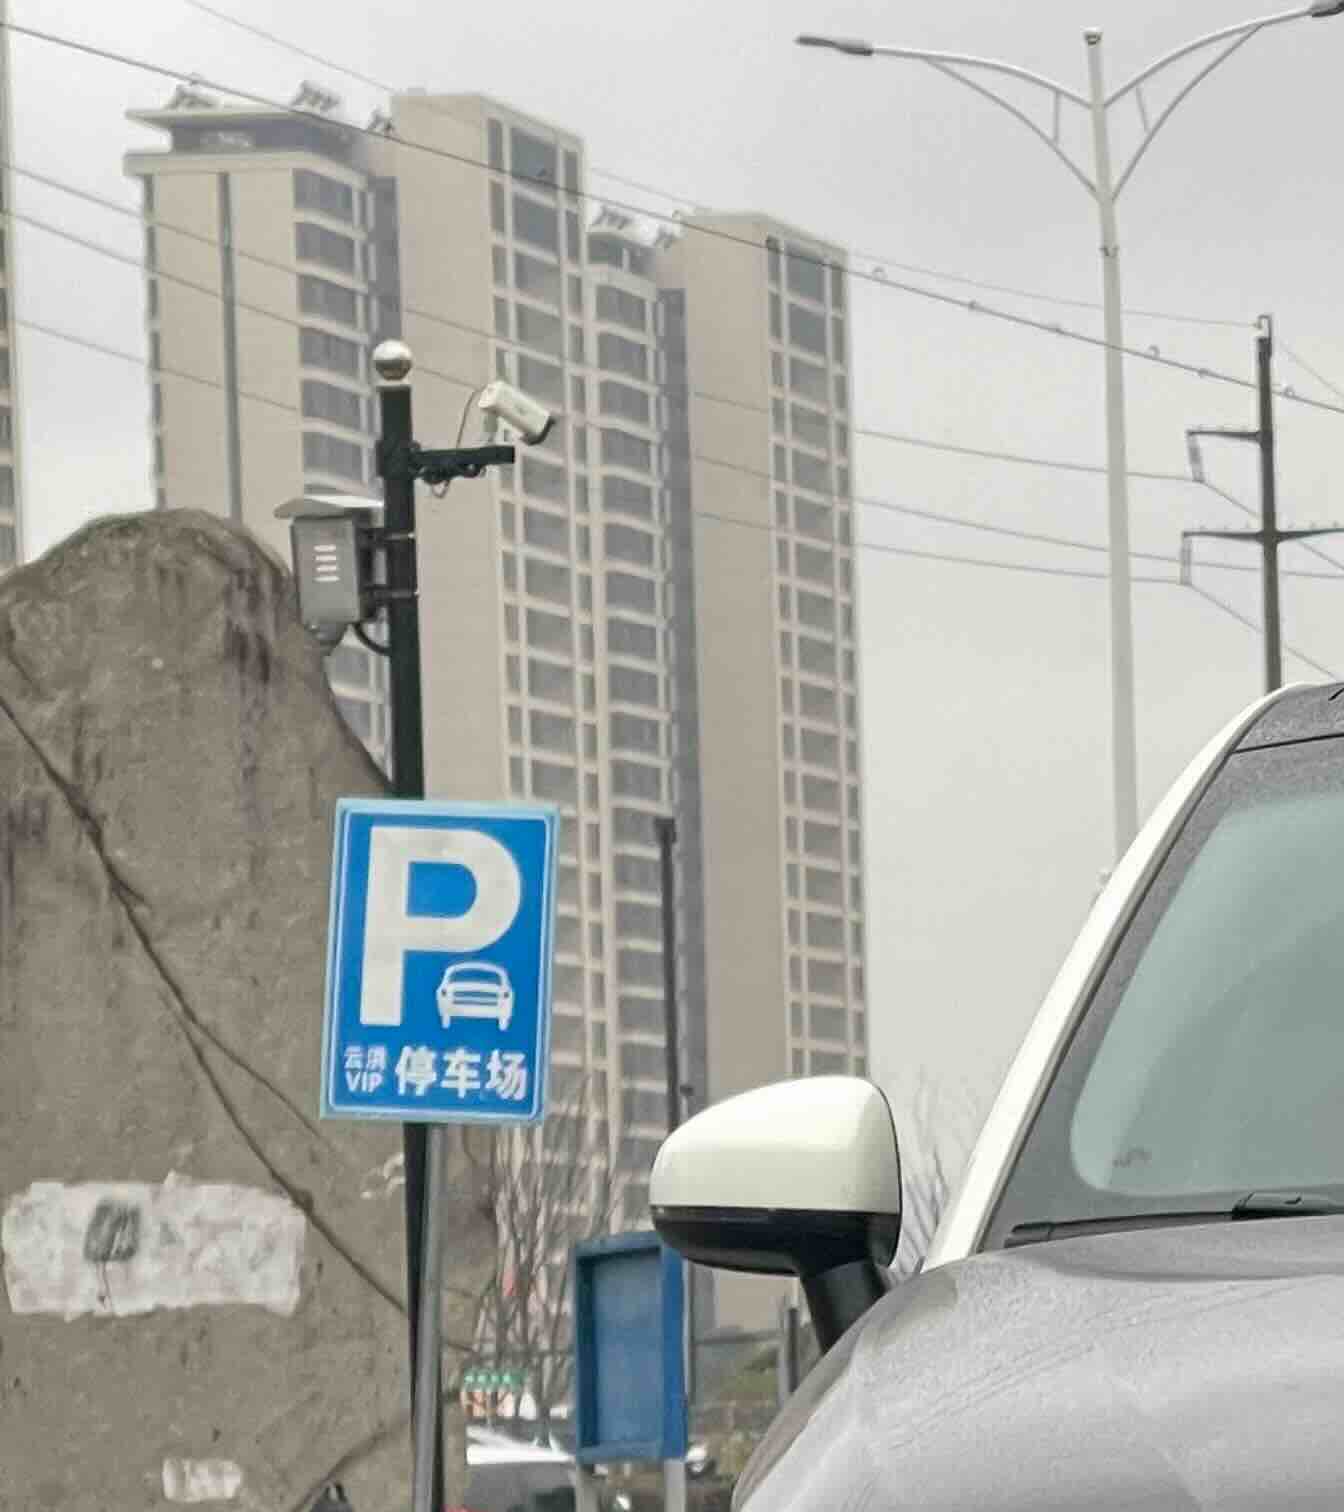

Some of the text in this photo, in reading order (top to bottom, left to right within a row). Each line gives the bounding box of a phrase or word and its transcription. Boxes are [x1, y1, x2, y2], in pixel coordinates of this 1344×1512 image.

[360, 826, 521, 1025] P
[345, 1070, 384, 1093] VIP
[395, 1045, 528, 1101] 停车场
